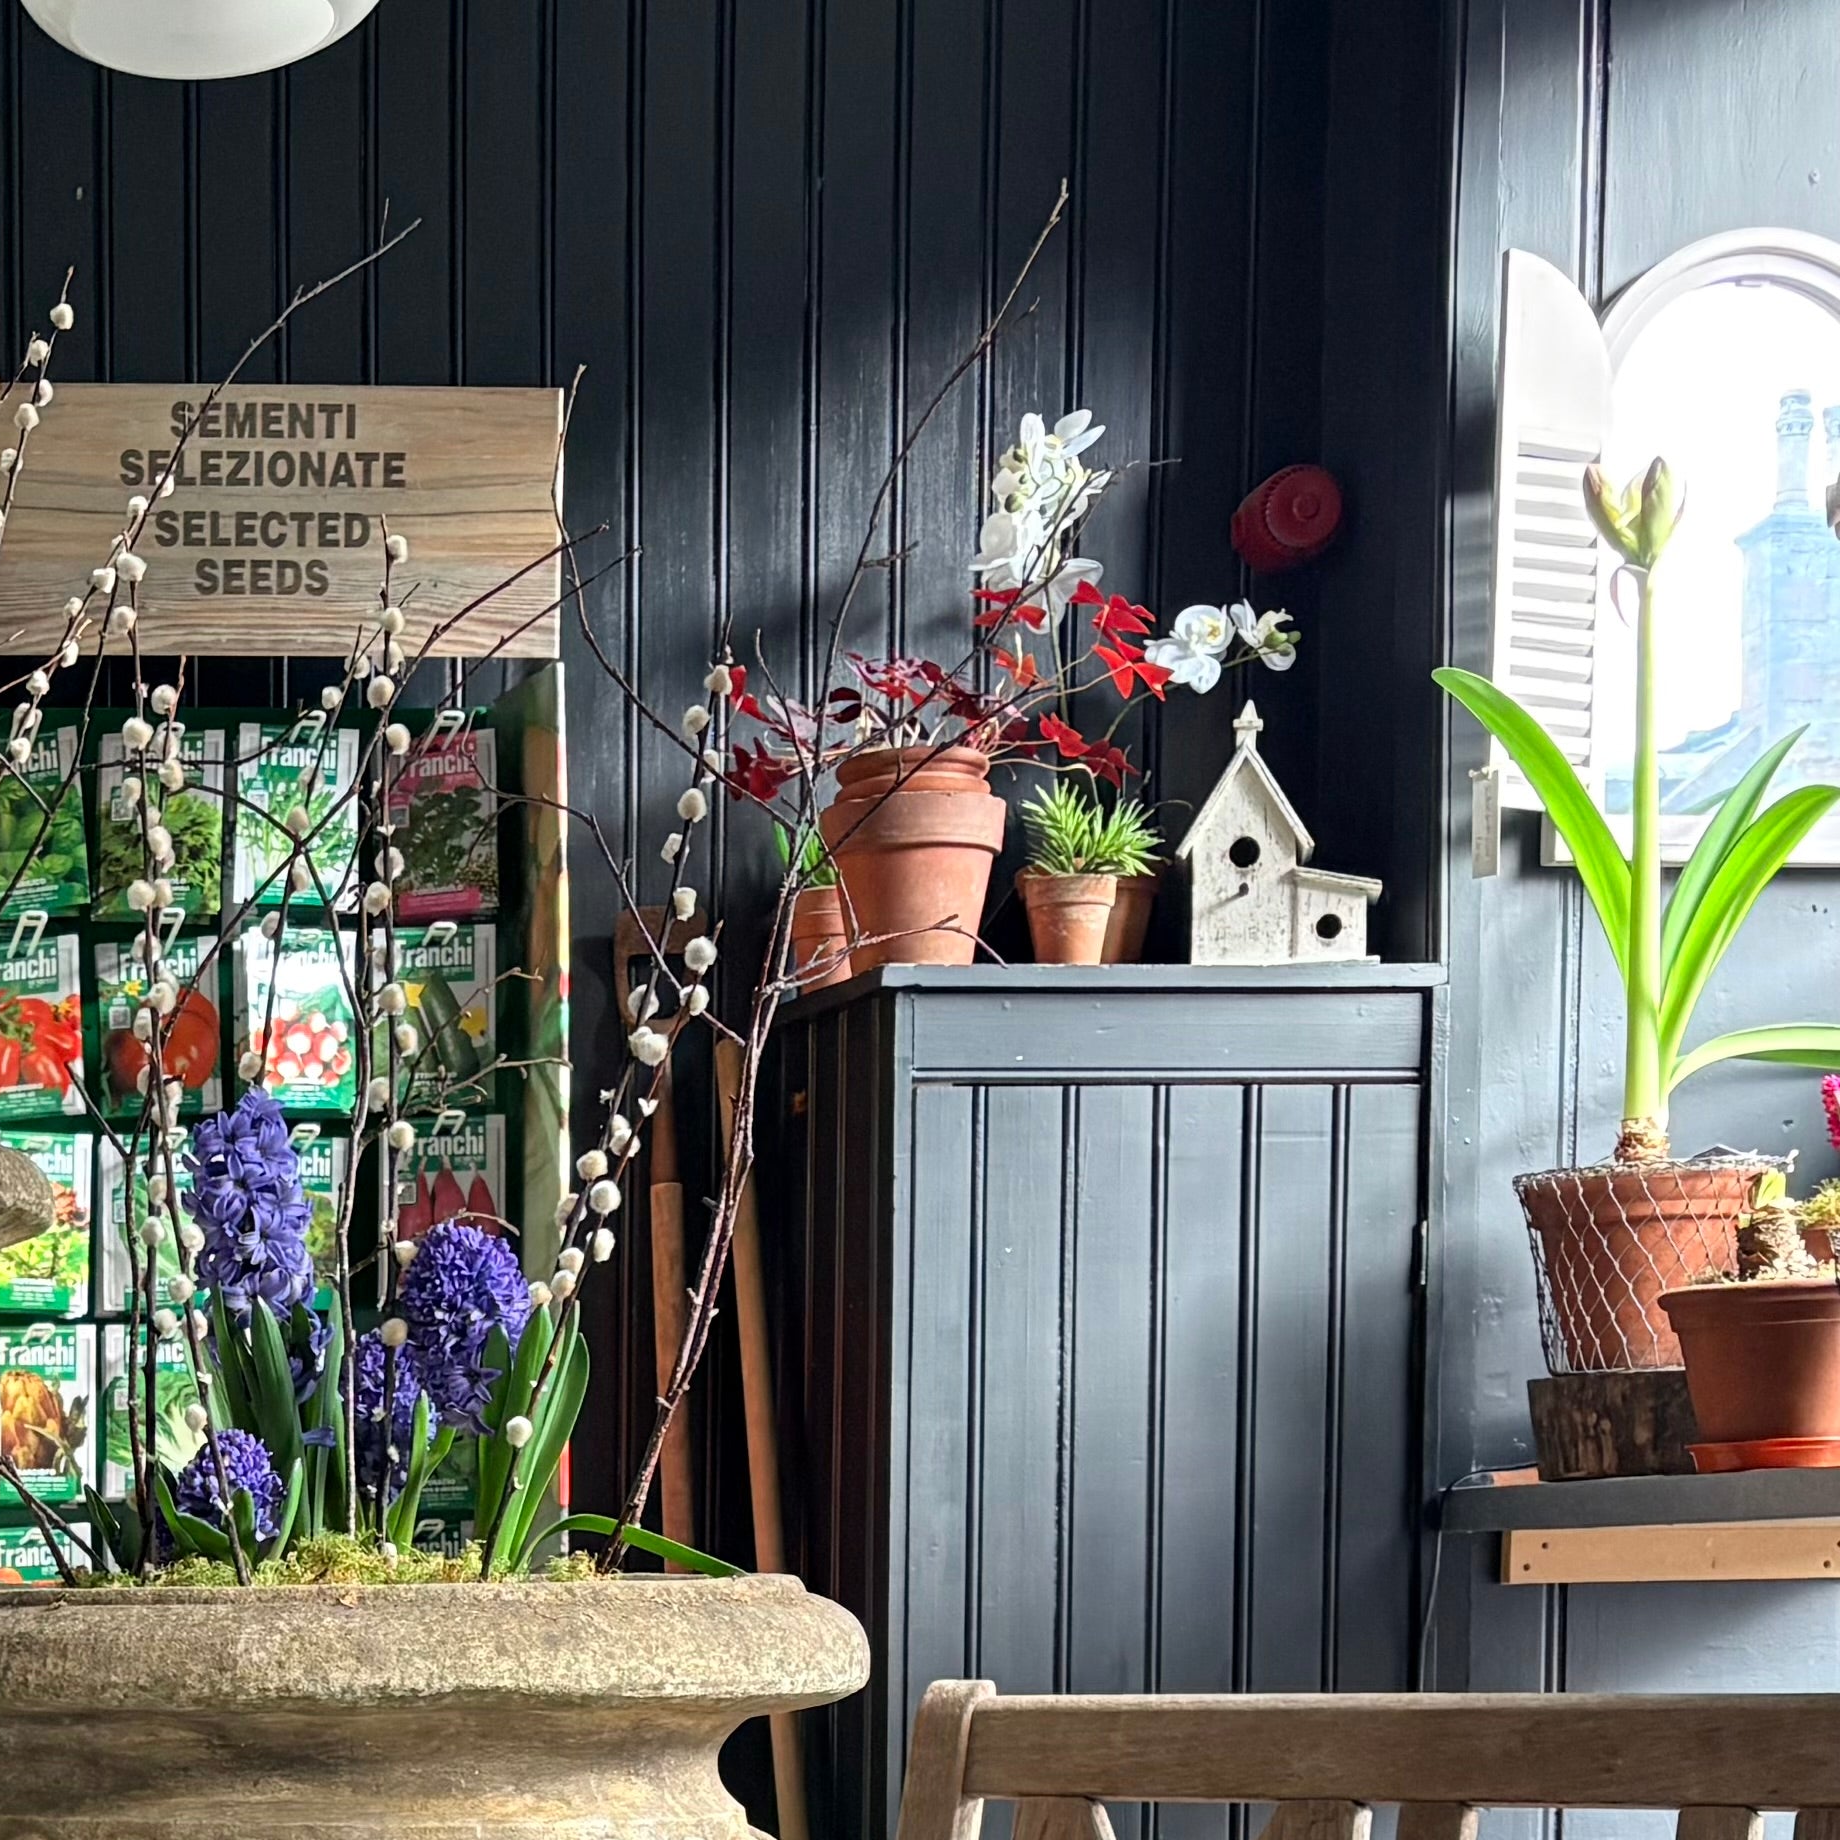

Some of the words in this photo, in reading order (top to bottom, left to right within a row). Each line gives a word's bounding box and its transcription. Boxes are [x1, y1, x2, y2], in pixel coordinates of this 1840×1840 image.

[171, 400, 357, 440] SEMENTI
[119, 449, 408, 489] SELEZIONATE
[154, 510, 372, 549] SELECTED
[194, 558, 331, 597] SEEDS
[394, 936, 472, 970] Franchi
